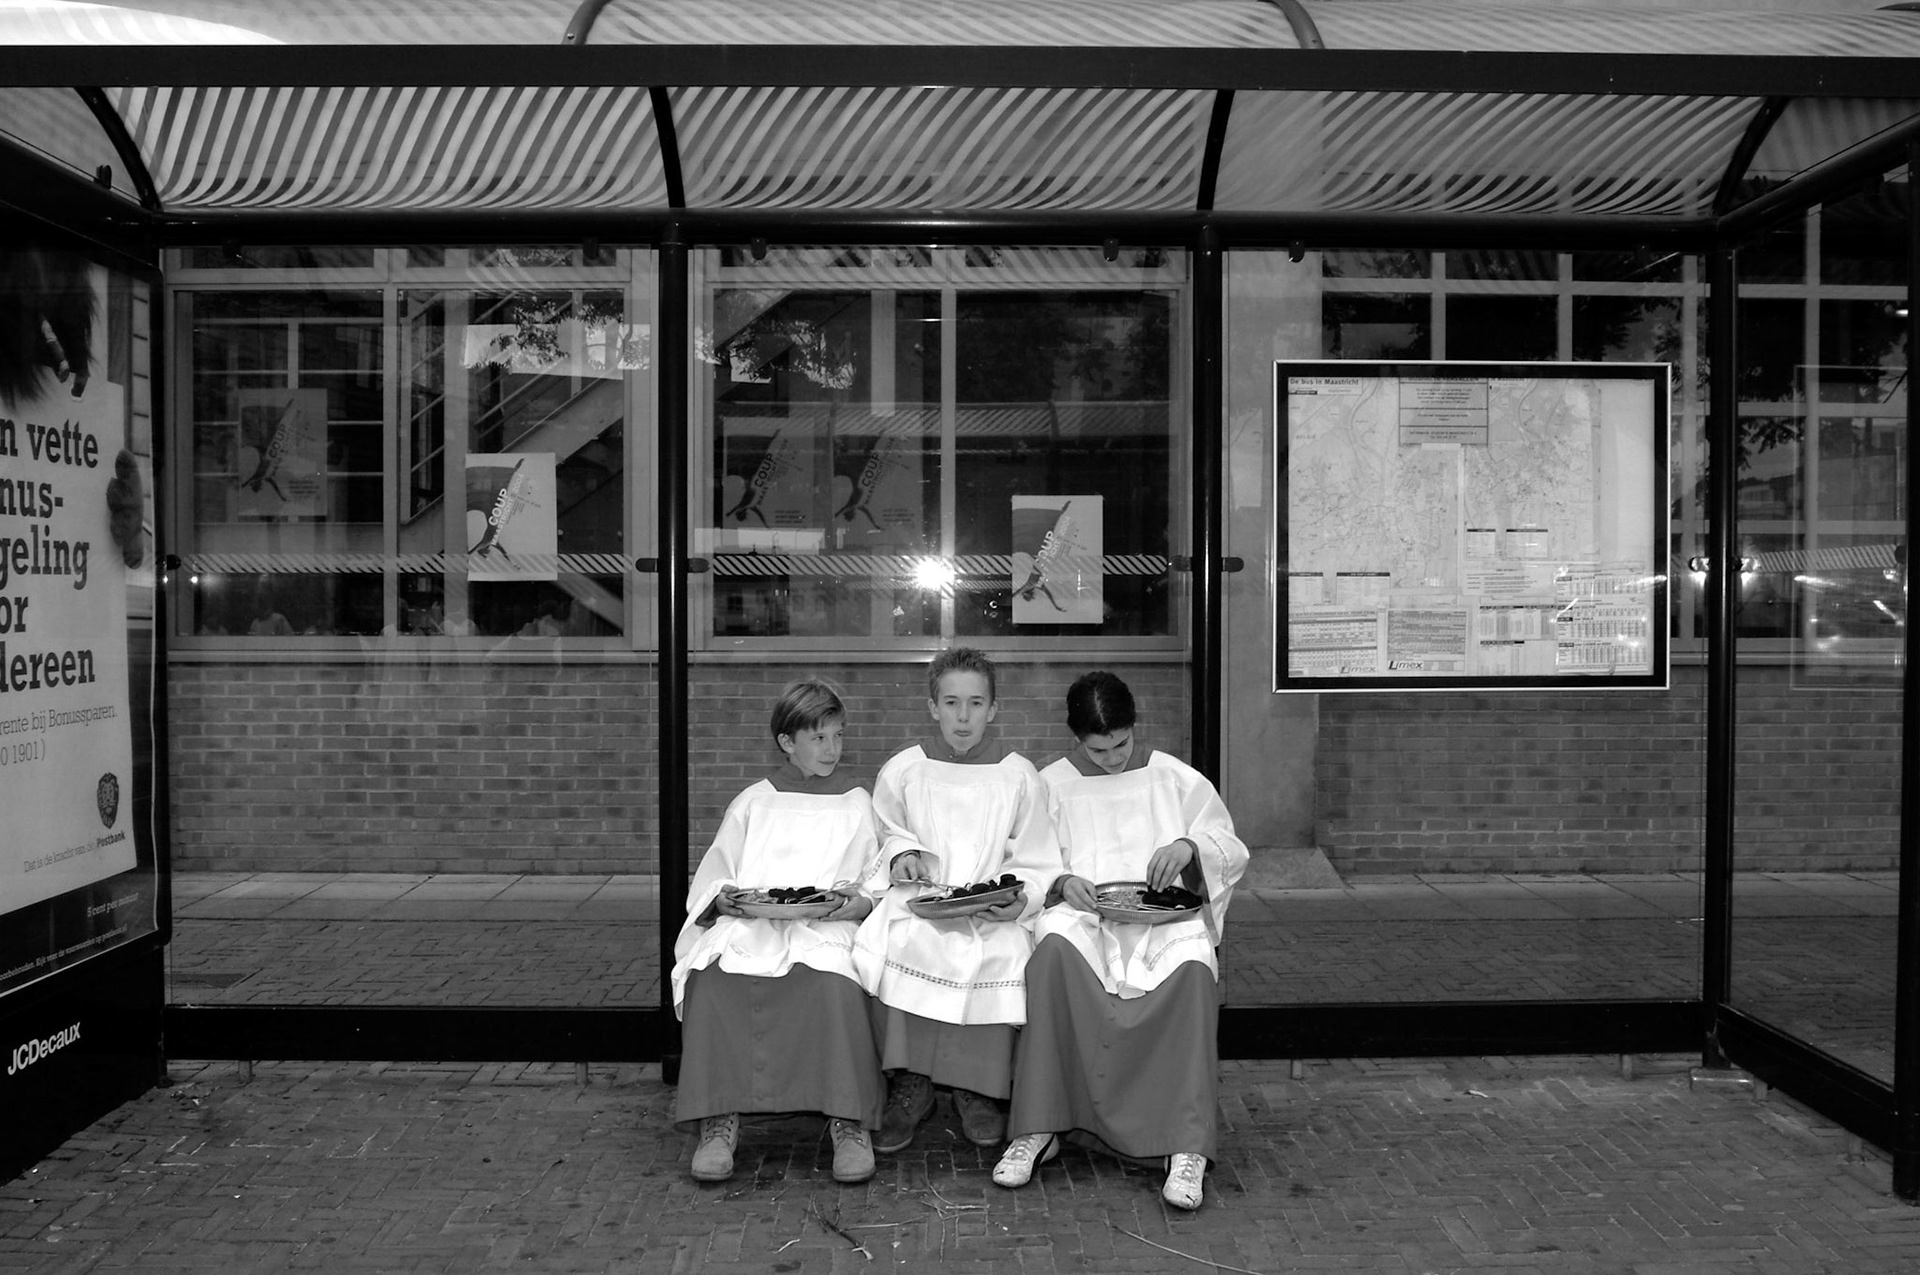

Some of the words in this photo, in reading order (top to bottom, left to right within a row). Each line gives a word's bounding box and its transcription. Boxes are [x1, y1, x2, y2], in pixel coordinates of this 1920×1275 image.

[26, 418, 98, 468] vette
[269, 423, 287, 458] COUP
[754, 452, 775, 488] COUP
[862, 452, 881, 488] COUP
[488, 488, 508, 526] COUP
[490, 497, 514, 546] MAASTRICHT
[513, 473, 525, 493] 2004
[32, 711, 46, 733] bij
[49, 706, 118, 727] Bonussparen.
[24, 860, 36, 873] Dat
[97, 830, 125, 848] Postbank
[92, 903, 106, 916] cent
[107, 900, 118, 913] per
[7, 1021, 81, 1076] JCDecaux
